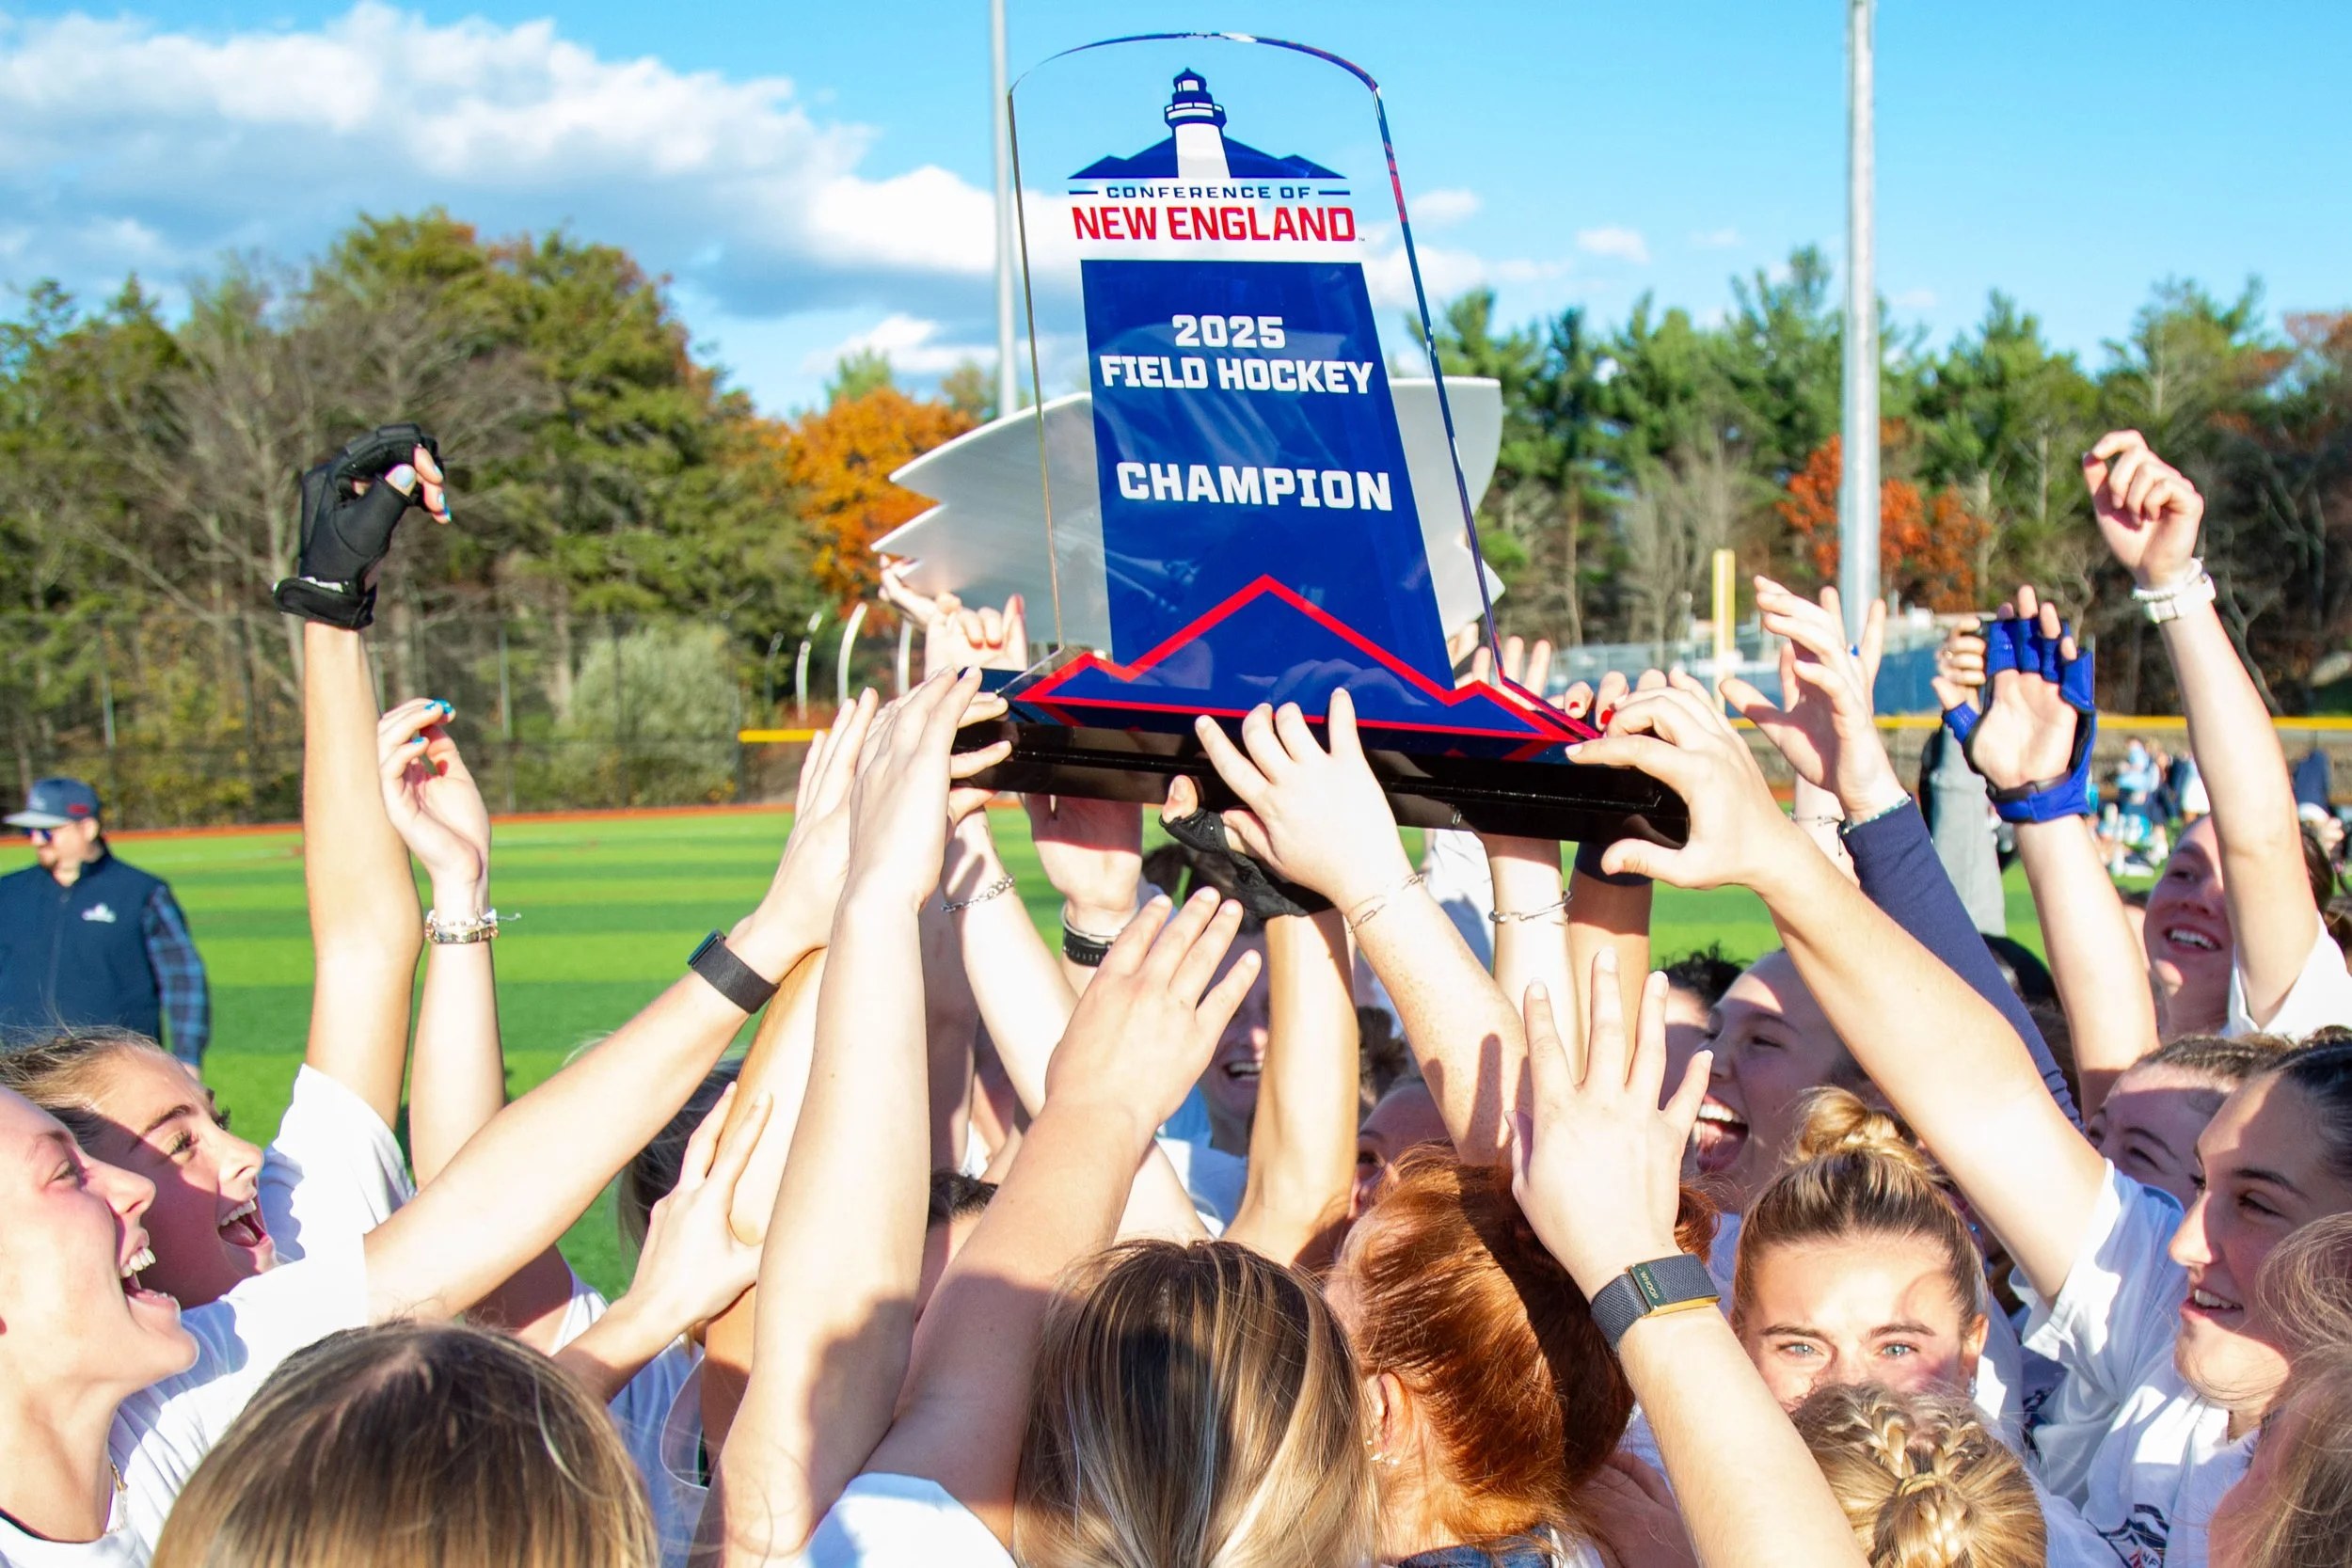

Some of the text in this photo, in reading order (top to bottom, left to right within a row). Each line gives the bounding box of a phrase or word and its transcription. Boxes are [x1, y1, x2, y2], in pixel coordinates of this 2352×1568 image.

[1106, 186, 1311, 198] CONFERENCE OF
[1072, 207, 1156, 240] NEW
[1167, 207, 1356, 241] ENGLAND
[1171, 314, 1286, 349] 2025
[1099, 355, 1374, 394] FIELD HOCKEY
[1116, 462, 1392, 511] CHAMPION
[1640, 1271, 1659, 1299] WHOOP
